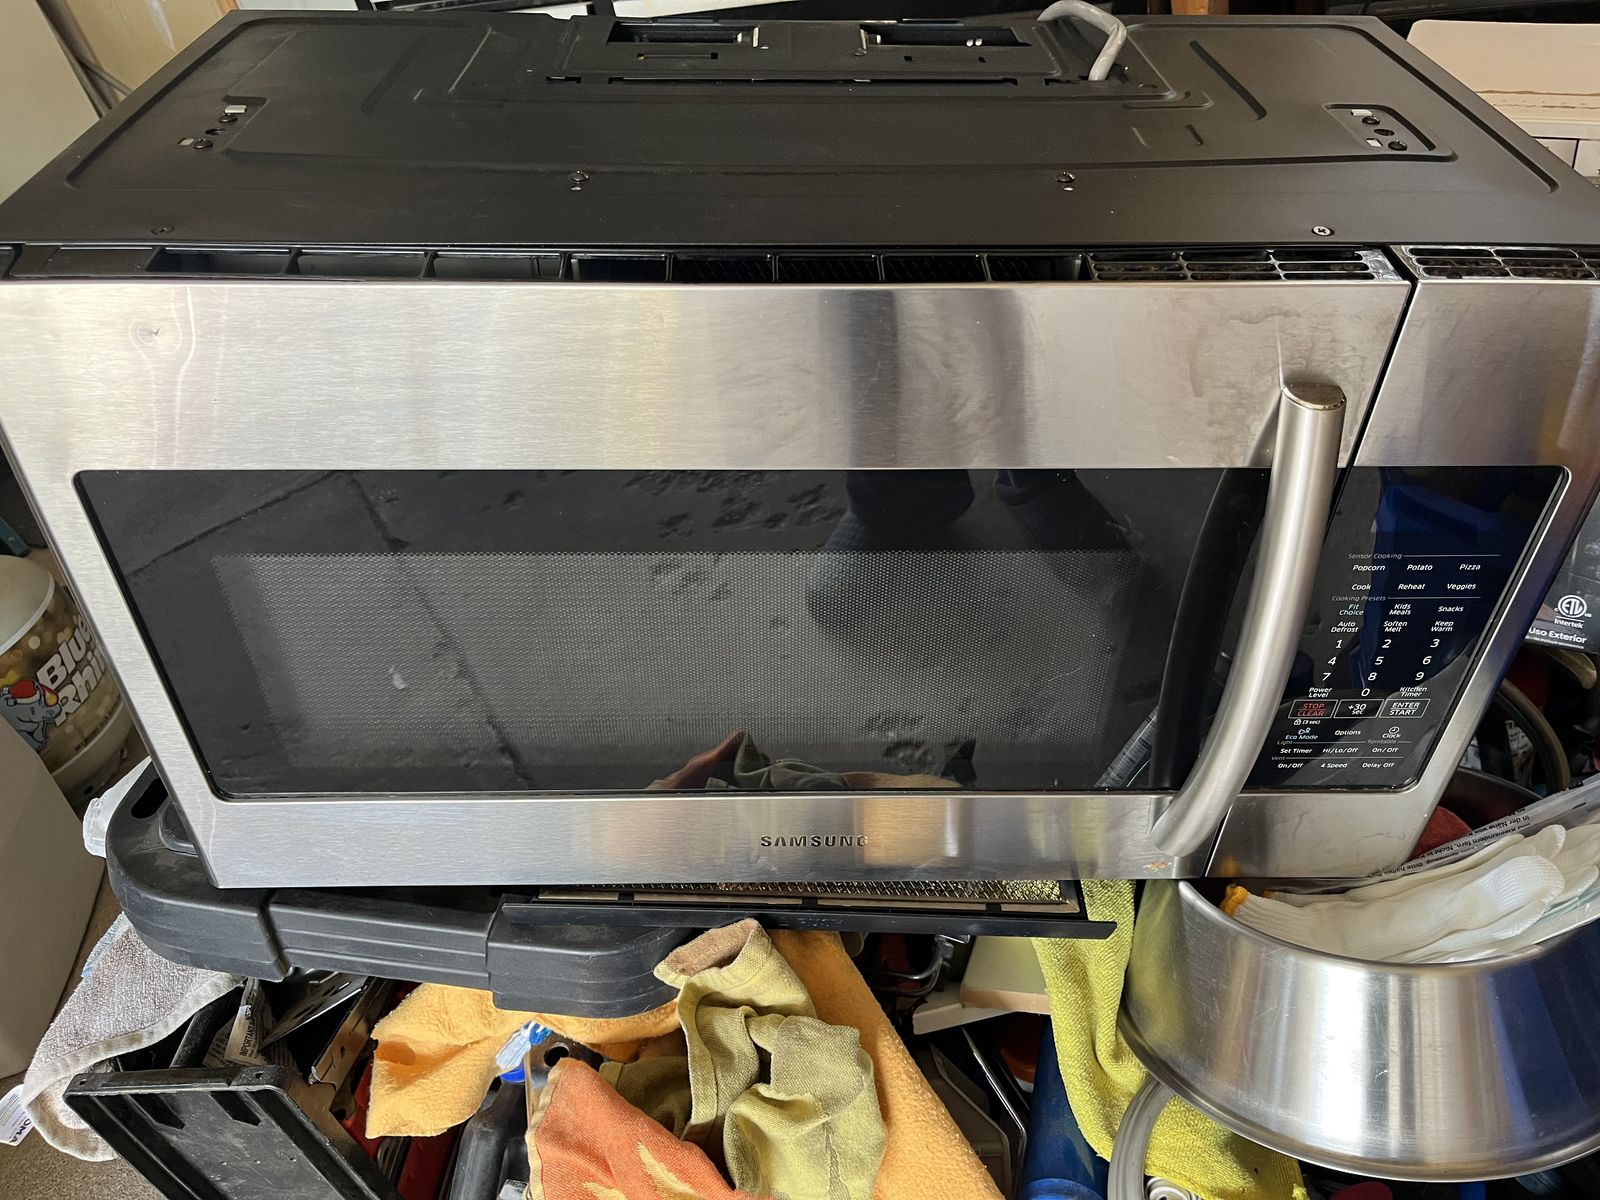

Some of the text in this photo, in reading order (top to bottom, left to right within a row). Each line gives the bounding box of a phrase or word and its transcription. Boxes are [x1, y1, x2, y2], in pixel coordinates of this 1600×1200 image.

[1352, 564, 1386, 572] Popcorn
[1406, 563, 1433, 571] Potato
[1351, 583, 1372, 591] Cook
[1446, 583, 1477, 591] Veggies
[1554, 618, 1583, 629] Intertek
[1528, 627, 1548, 636] Uso
[1549, 630, 1588, 643] Exterior
[1335, 639, 1342, 649] 1
[1381, 639, 1392, 649] 2
[1429, 638, 1440, 648] 3
[36, 614, 92, 692] Blue
[1327, 656, 1337, 666] 4
[1374, 656, 1384, 665] 5
[1422, 655, 1432, 665] 6
[1321, 672, 1331, 681] 7
[1367, 672, 1377, 681] 8
[1415, 671, 1425, 681] 9
[1360, 688, 1371, 697] 0
[760, 835, 868, 847] SAMSUNG
[239, 1022, 255, 1057] IMPORTANT
